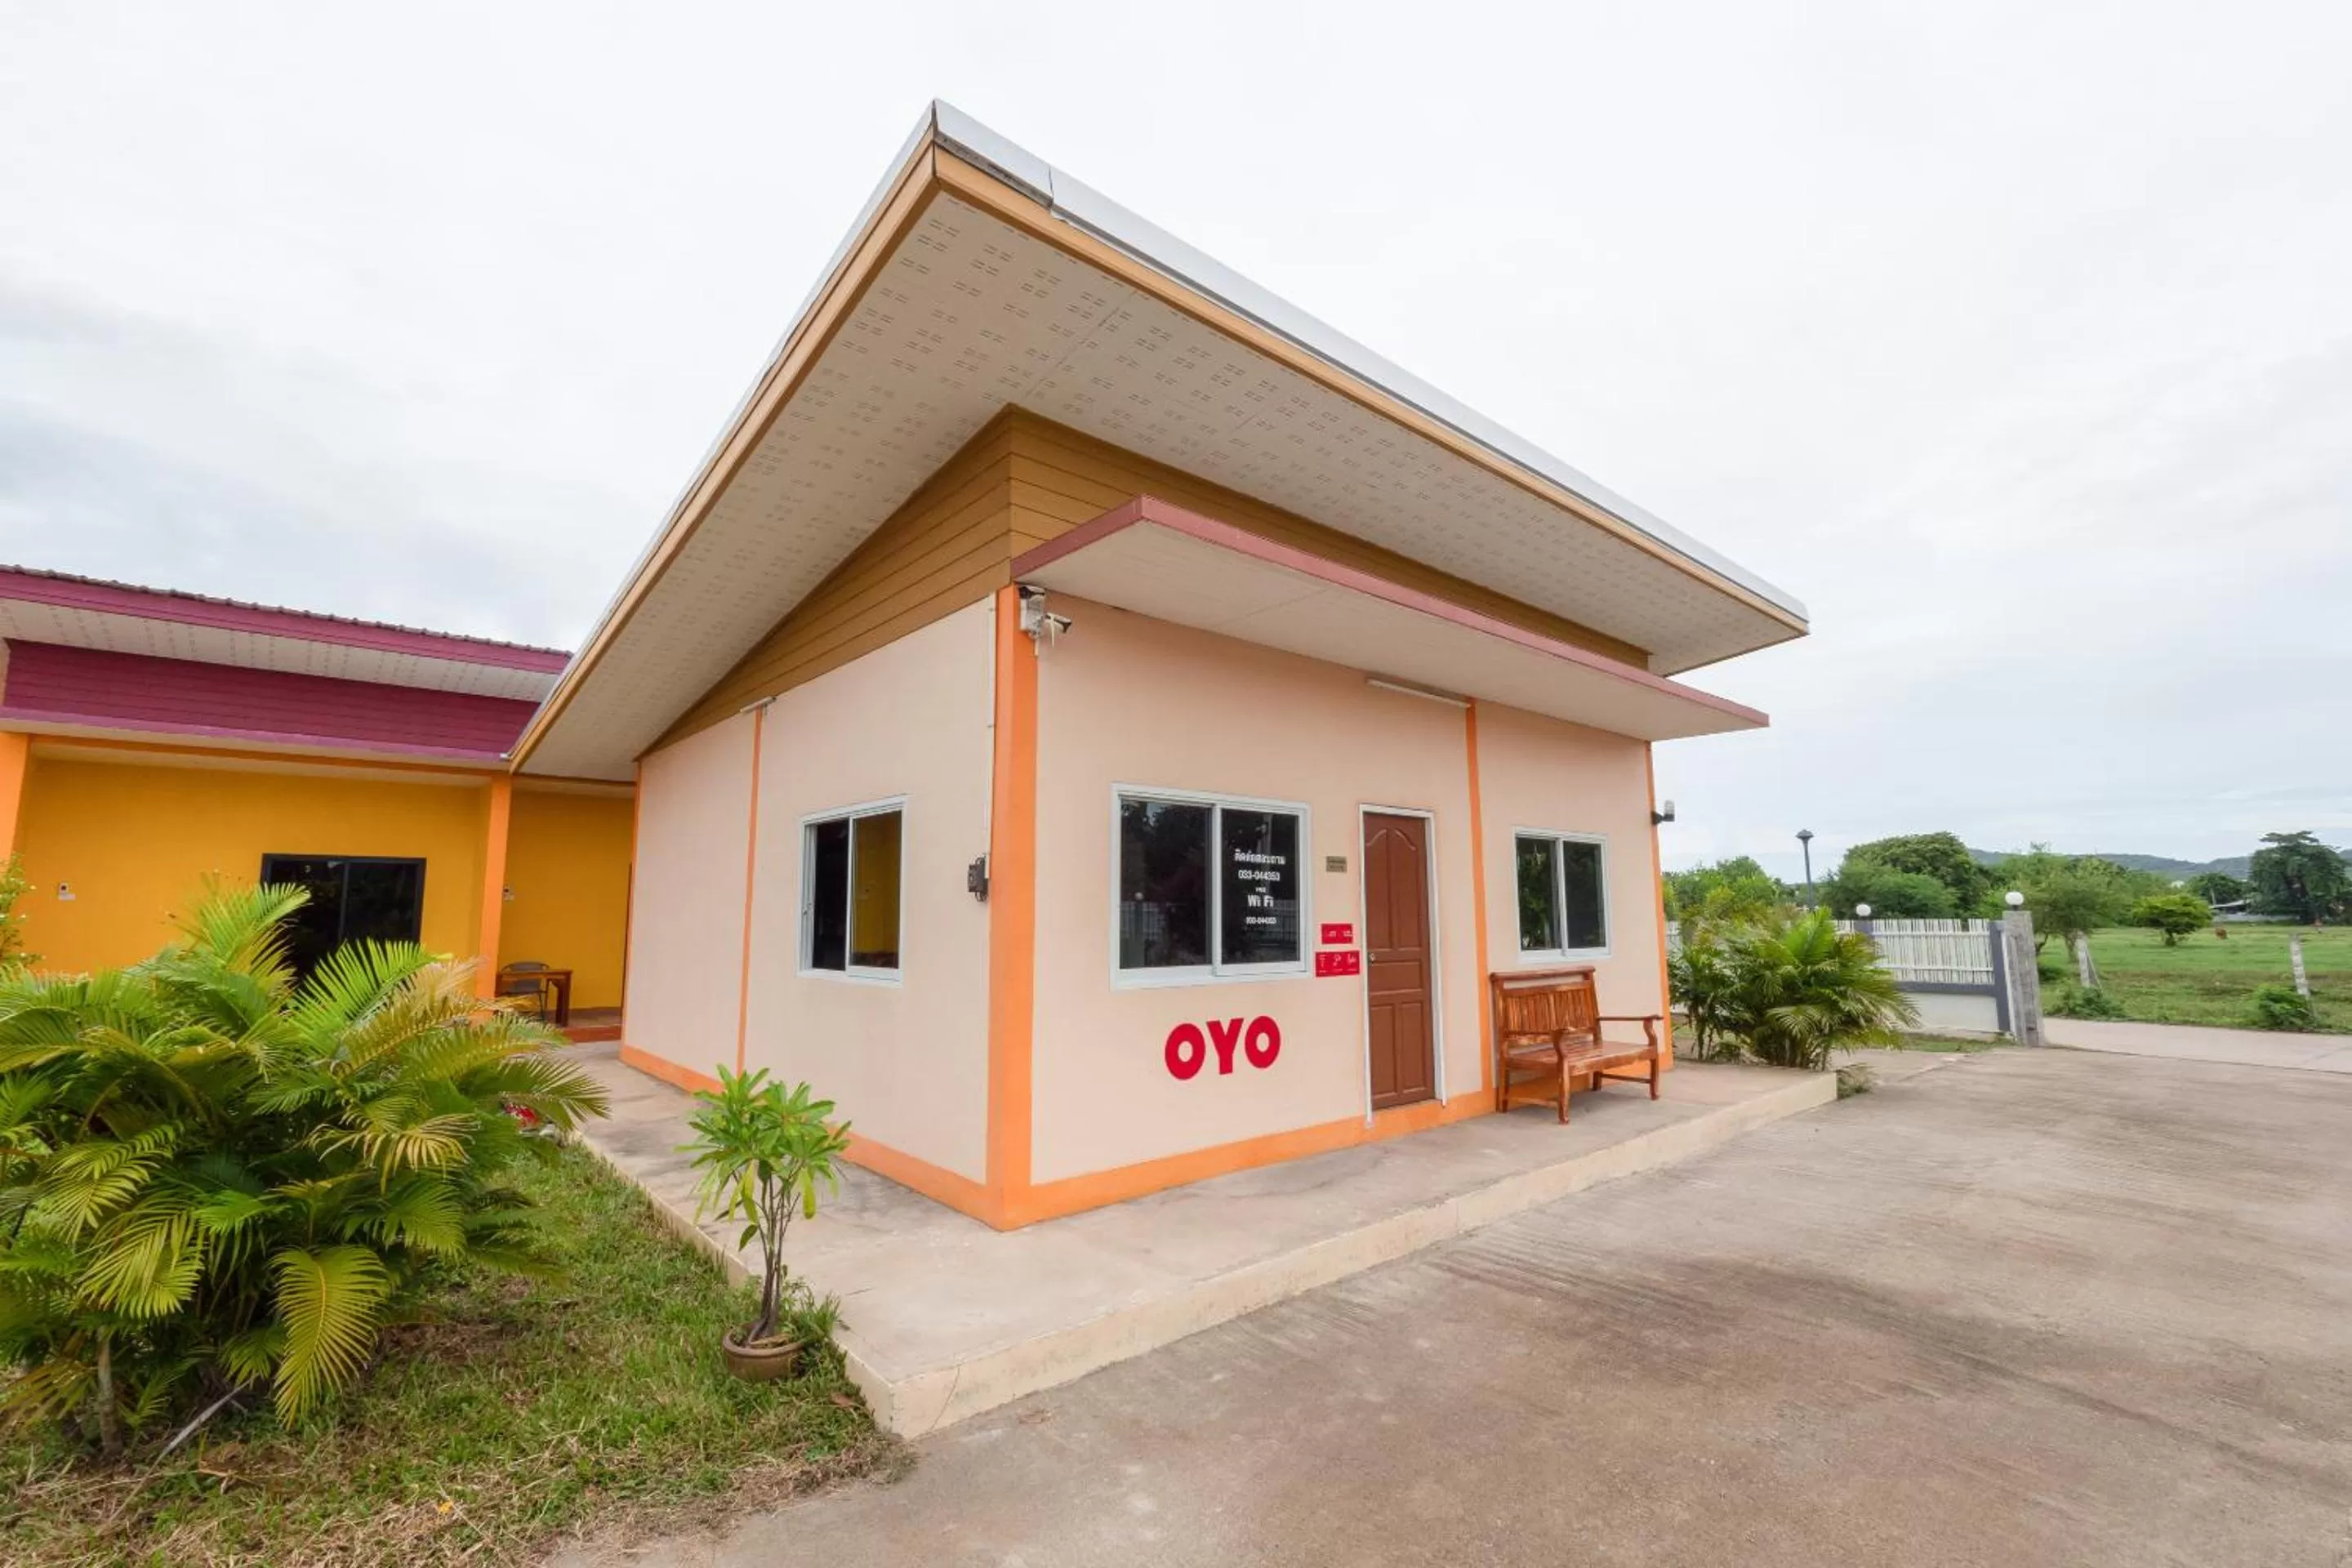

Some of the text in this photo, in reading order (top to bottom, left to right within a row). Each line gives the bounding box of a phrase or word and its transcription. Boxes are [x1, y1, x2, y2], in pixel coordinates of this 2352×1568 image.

[1248, 894, 1274, 908] Wi Fi
[1165, 1015, 1281, 1080] OYO
